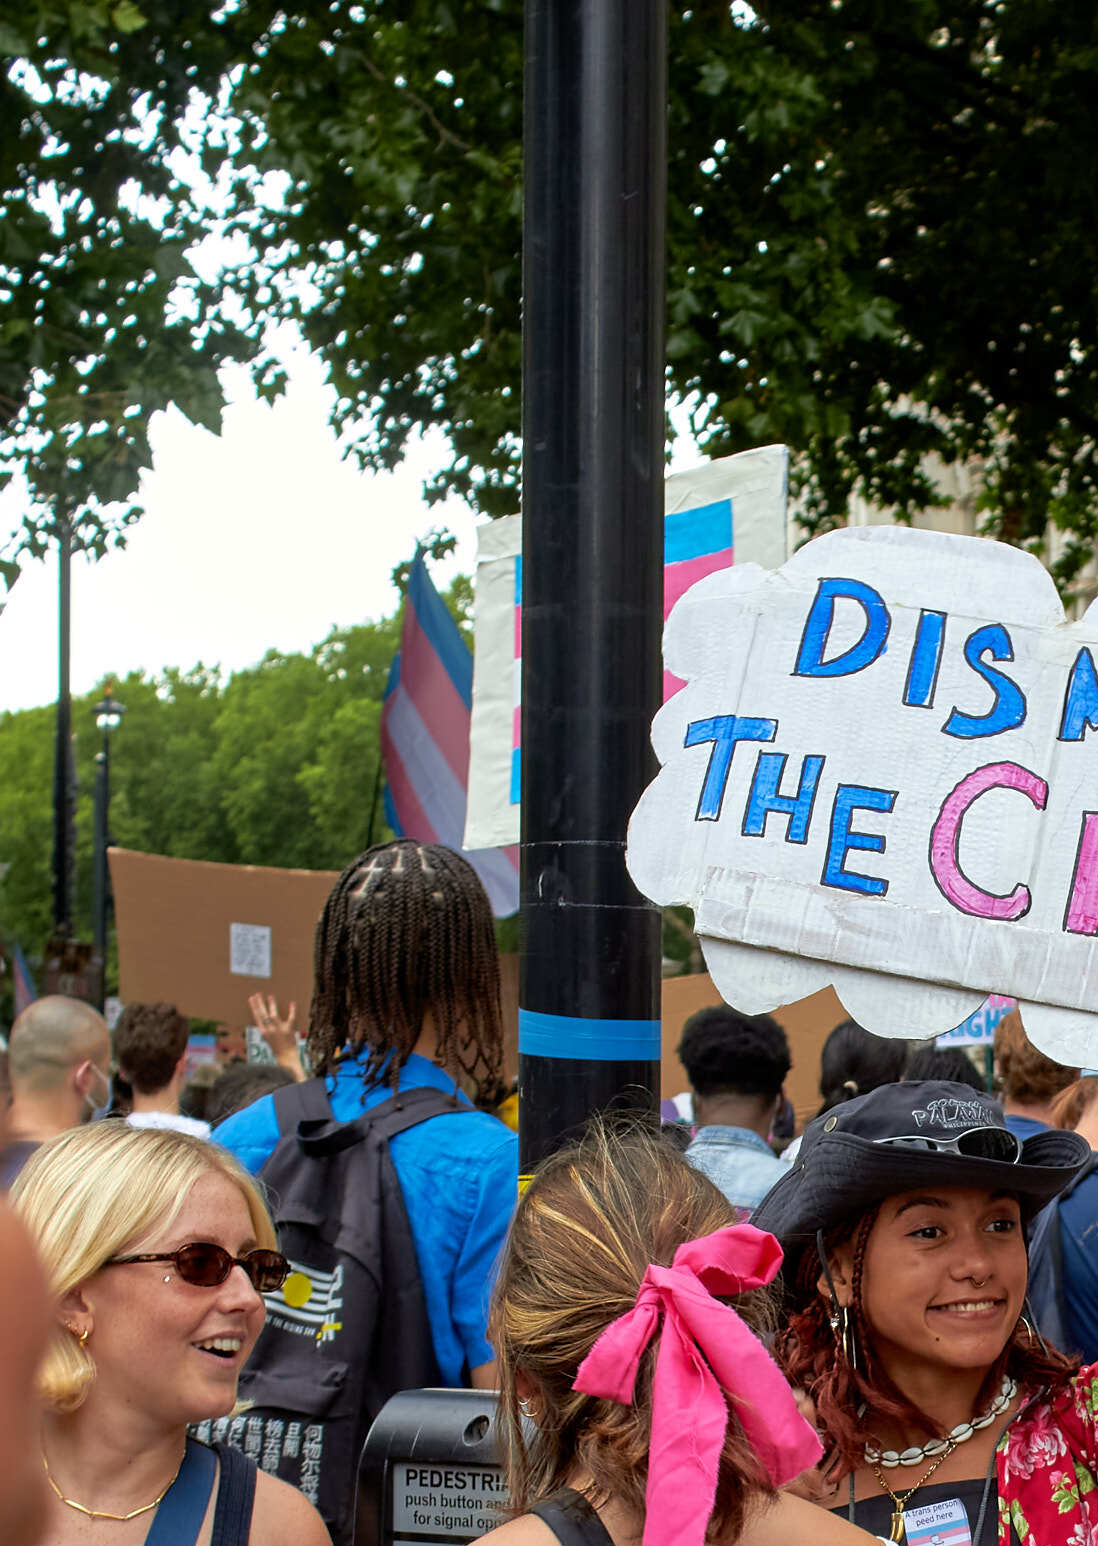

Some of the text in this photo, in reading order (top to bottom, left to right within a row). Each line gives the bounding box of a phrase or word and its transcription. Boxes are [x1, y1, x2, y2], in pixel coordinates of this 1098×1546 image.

[683, 713, 899, 896] THE
[405, 1493, 437, 1508] push
[440, 1493, 483, 1510] button
[905, 1499, 958, 1519] A trans person
[413, 1510, 432, 1525] for
[434, 1511, 474, 1530] signal
[915, 1515, 935, 1527] peed
